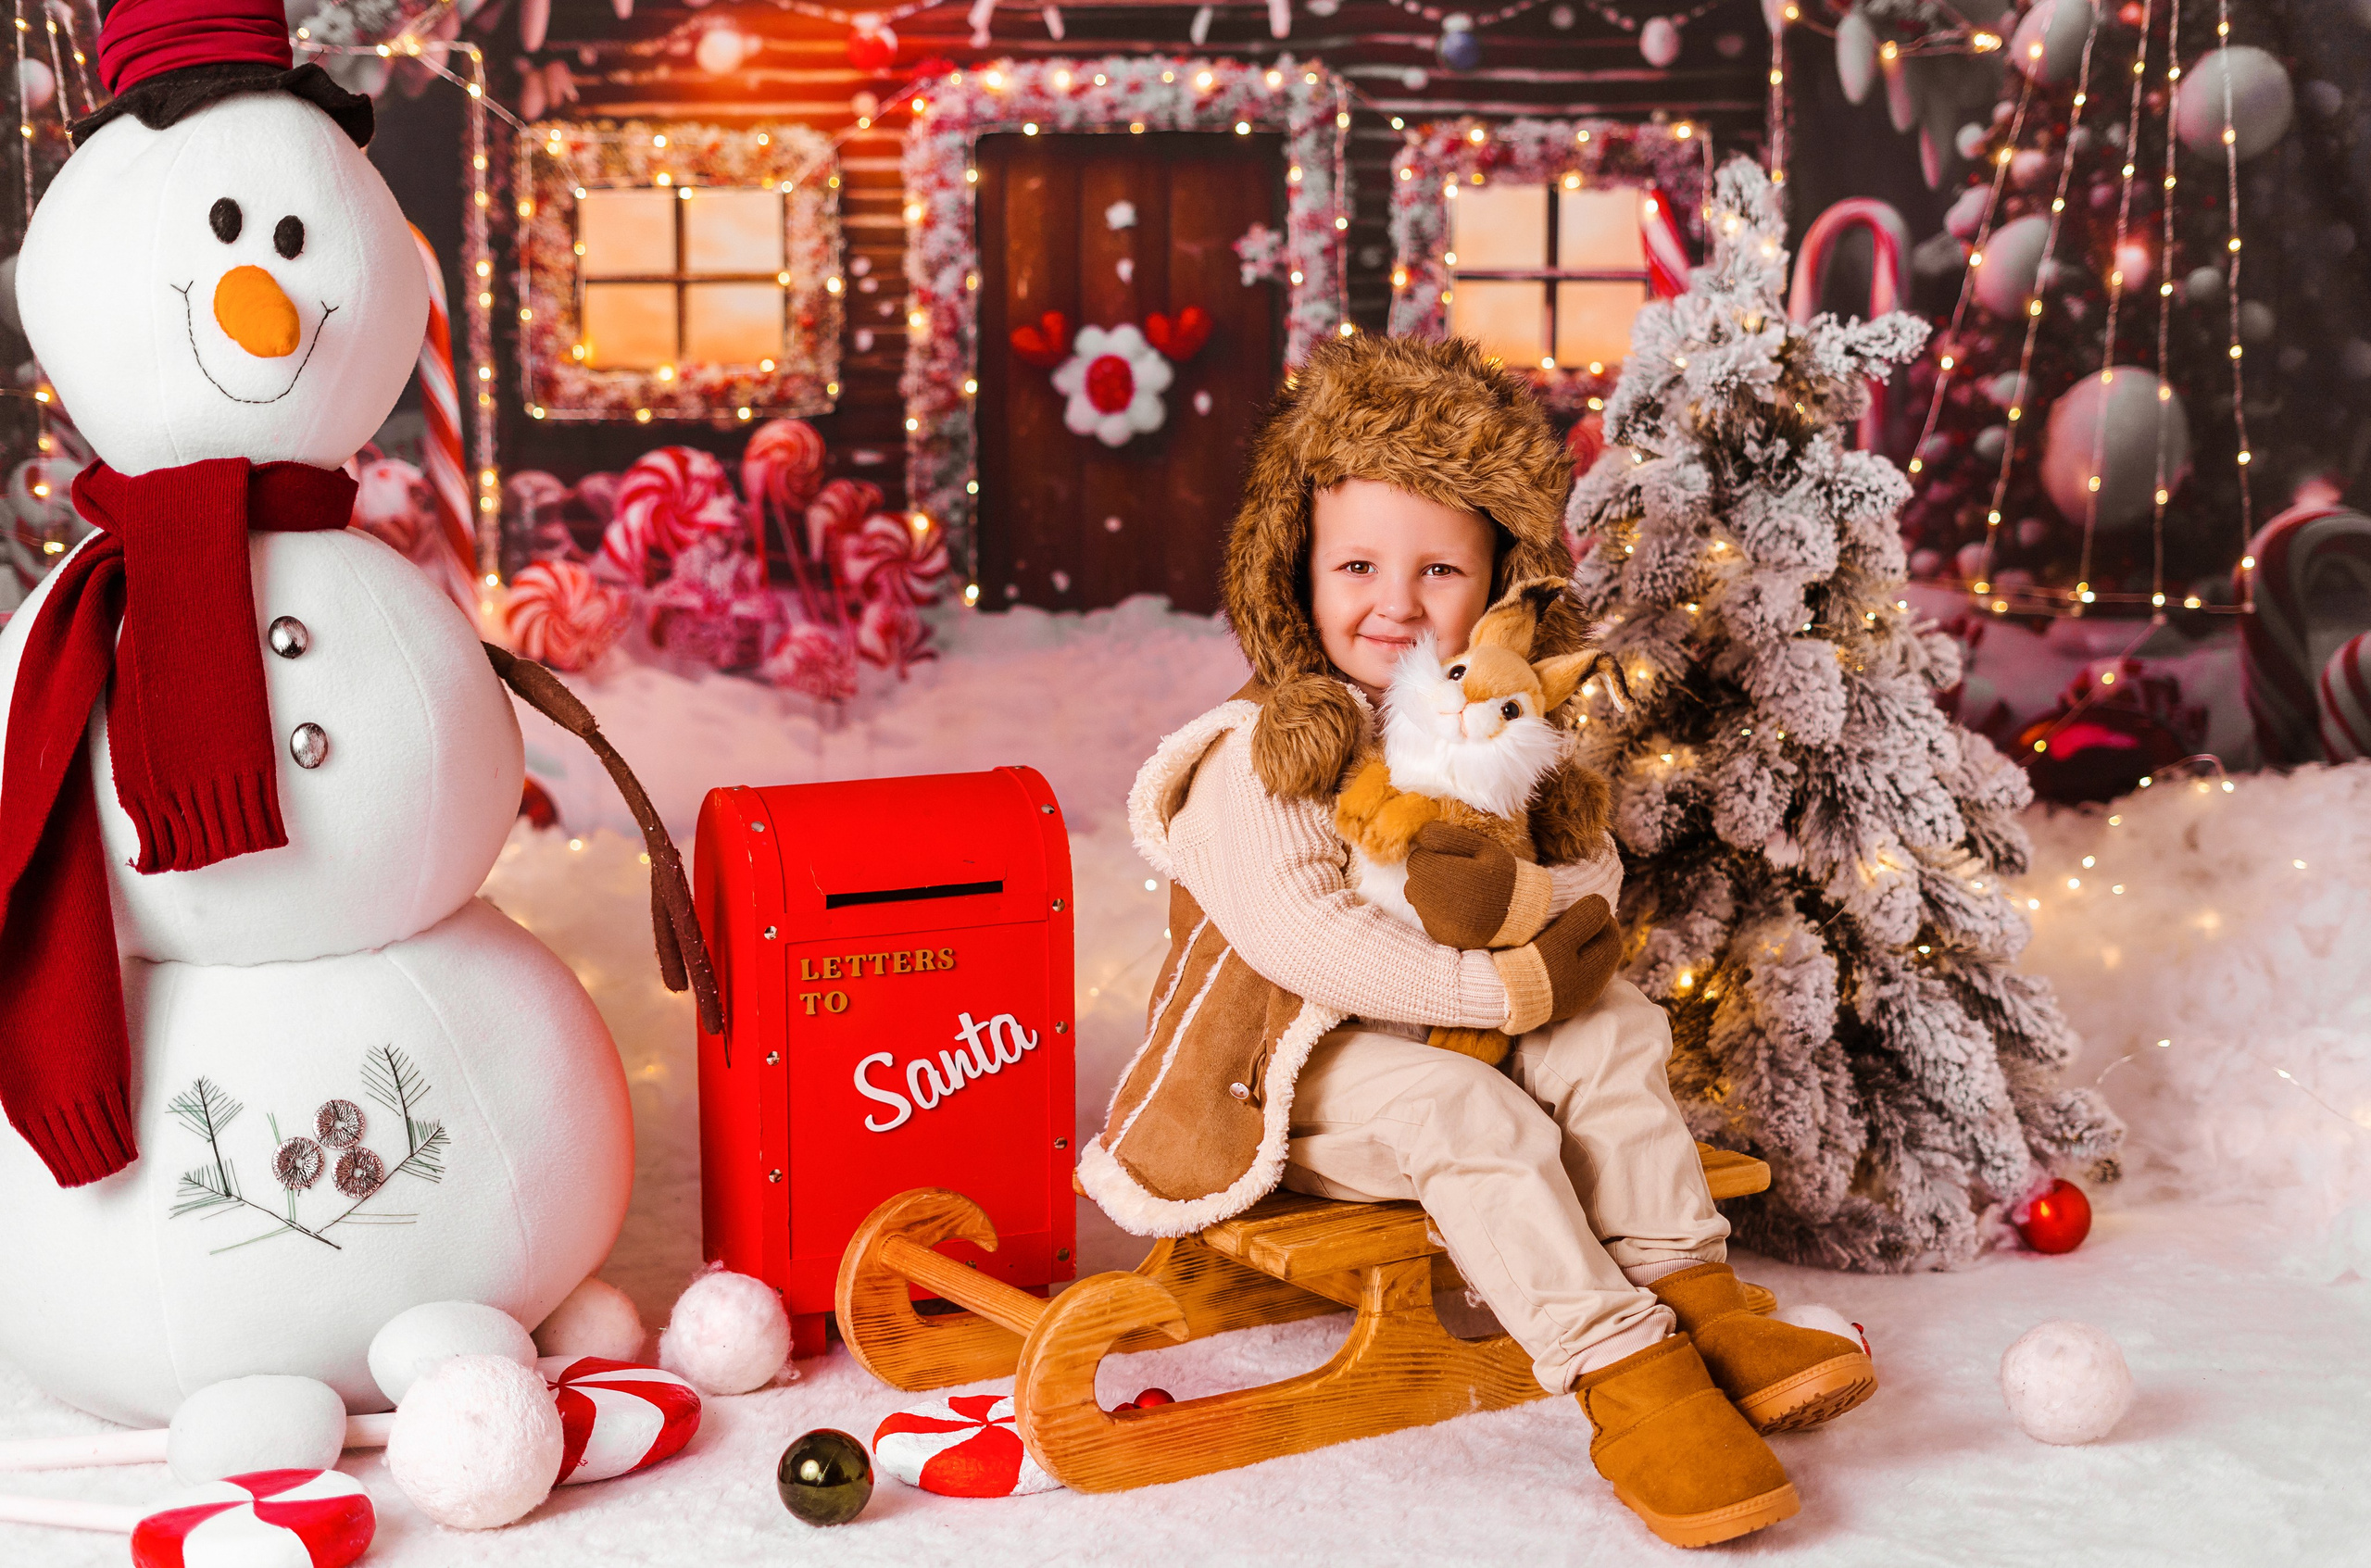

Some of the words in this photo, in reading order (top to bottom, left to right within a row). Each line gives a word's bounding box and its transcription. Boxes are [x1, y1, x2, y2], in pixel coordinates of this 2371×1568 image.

[800, 947, 955, 981] LETTERS
[799, 991, 848, 1015] TO
[853, 1012, 1038, 1133] Santa
